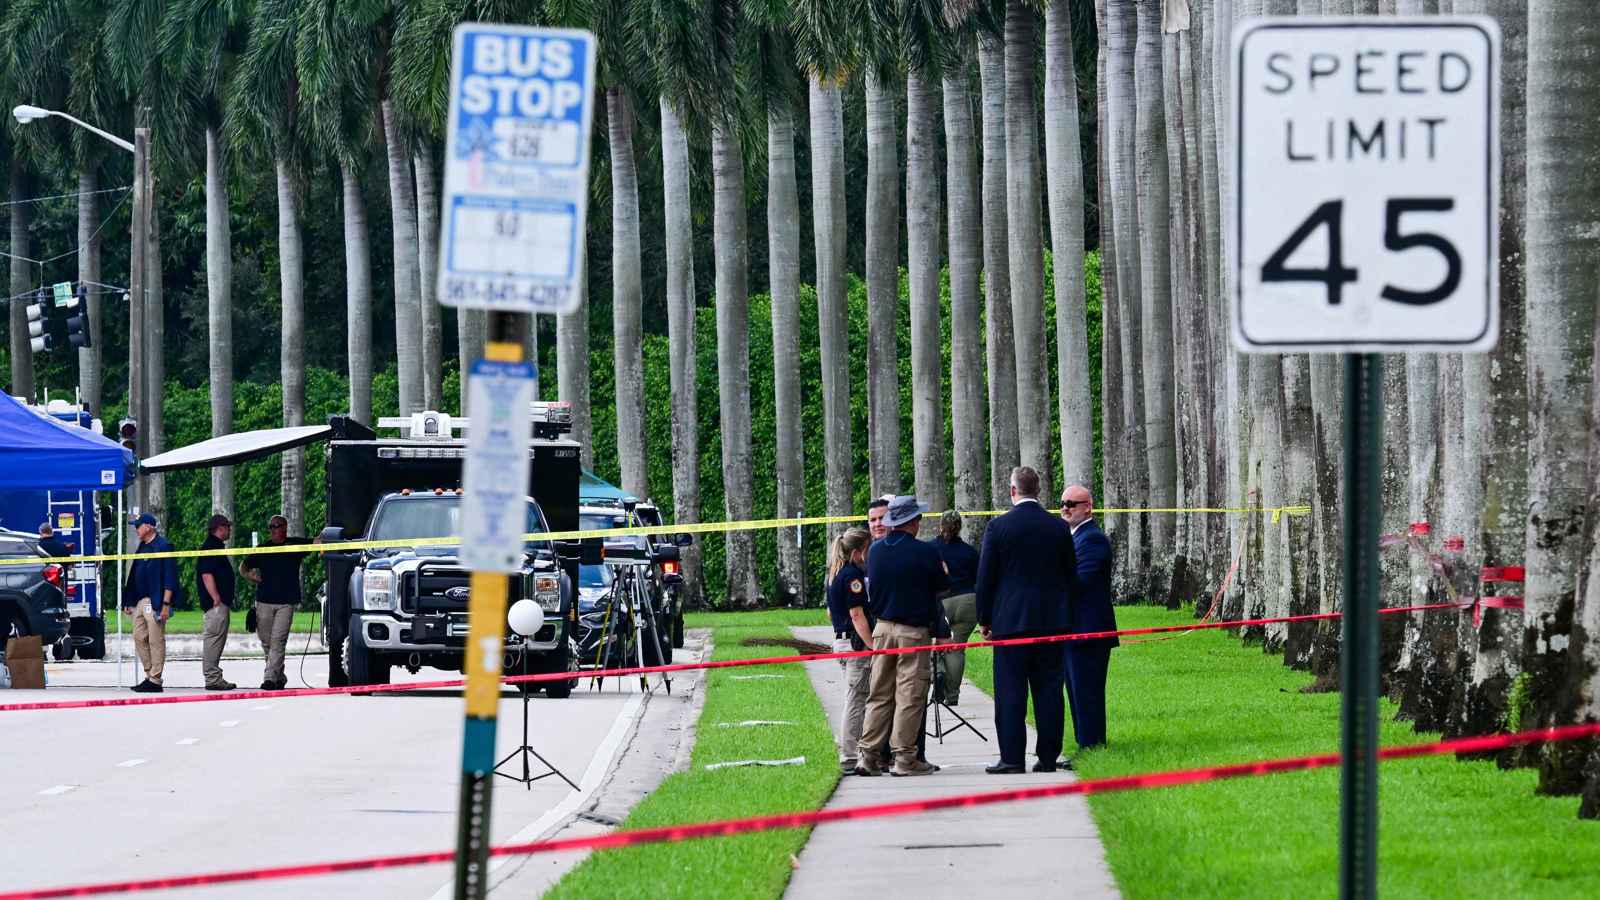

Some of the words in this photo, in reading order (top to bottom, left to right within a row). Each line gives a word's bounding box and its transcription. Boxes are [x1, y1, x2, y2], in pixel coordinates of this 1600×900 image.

[473, 34, 573, 79] BUS
[1264, 51, 1471, 94] SPEED
[461, 76, 581, 117] STOP
[1285, 117, 1447, 161] LIMIT
[1260, 197, 1463, 306] 45
